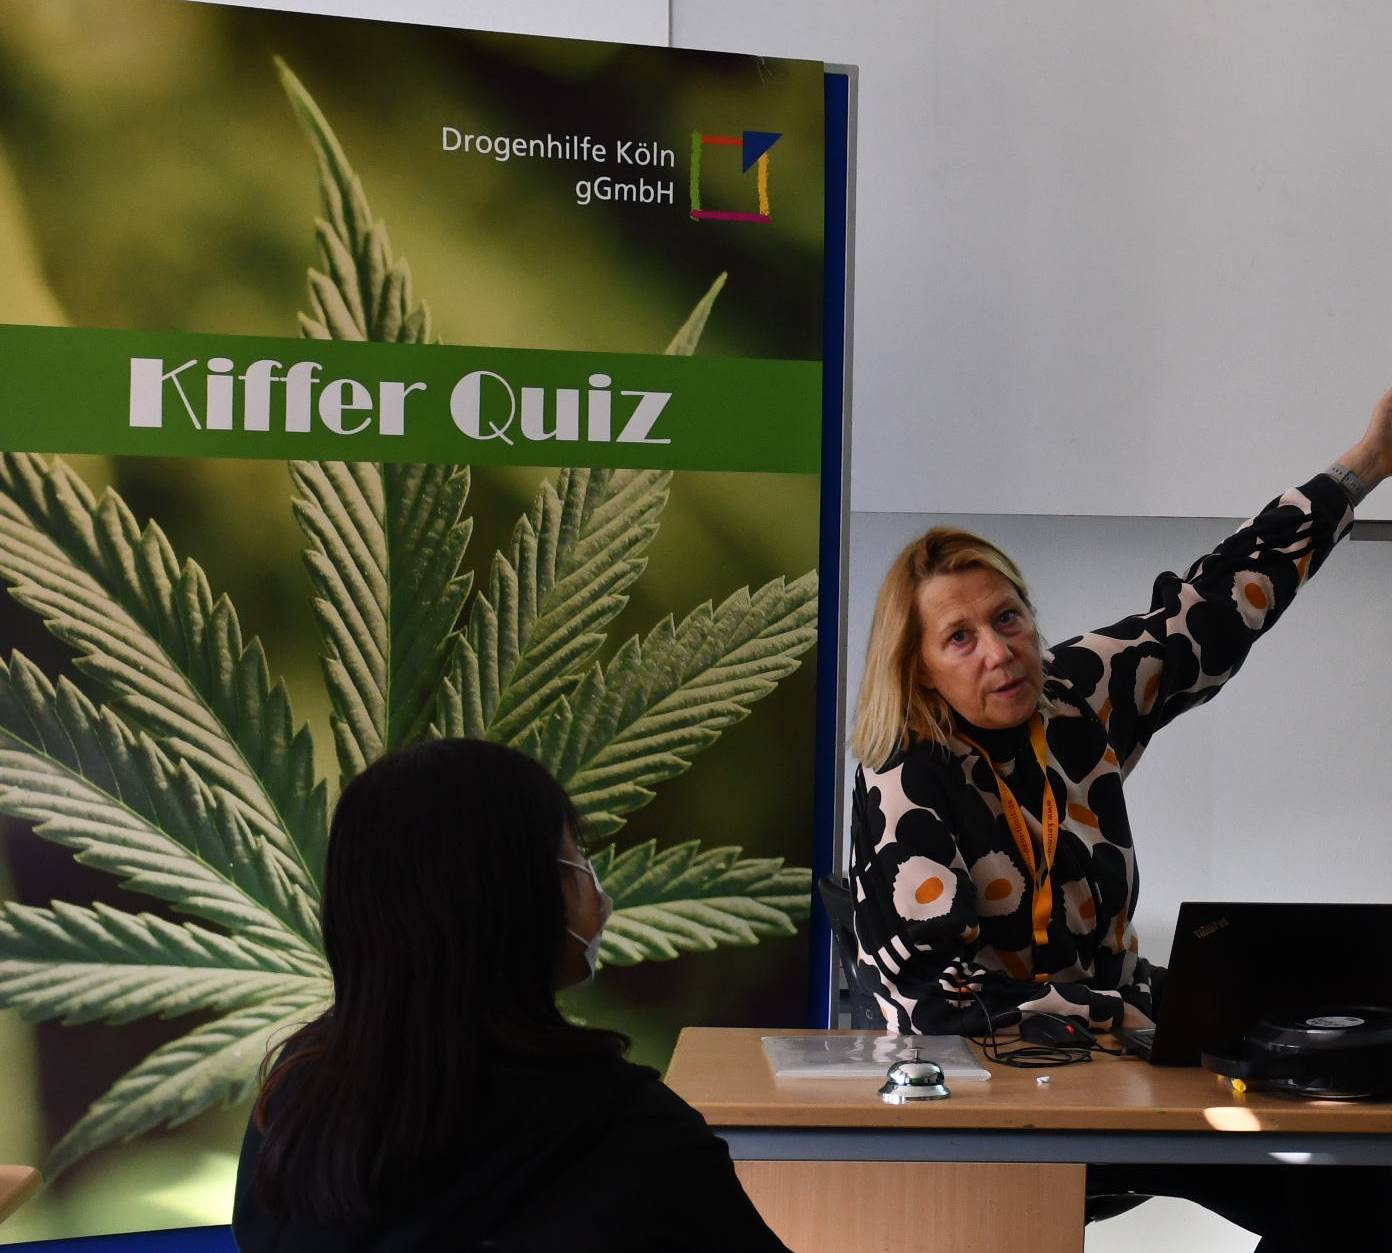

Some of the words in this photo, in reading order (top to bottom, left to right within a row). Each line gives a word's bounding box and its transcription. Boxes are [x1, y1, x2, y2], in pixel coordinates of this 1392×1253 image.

[441, 126, 607, 162] Drogenhilfe
[616, 139, 675, 168] Köln
[575, 175, 674, 205] gGmbH
[129, 356, 428, 436] Kiffer
[449, 370, 673, 446] Quiz
